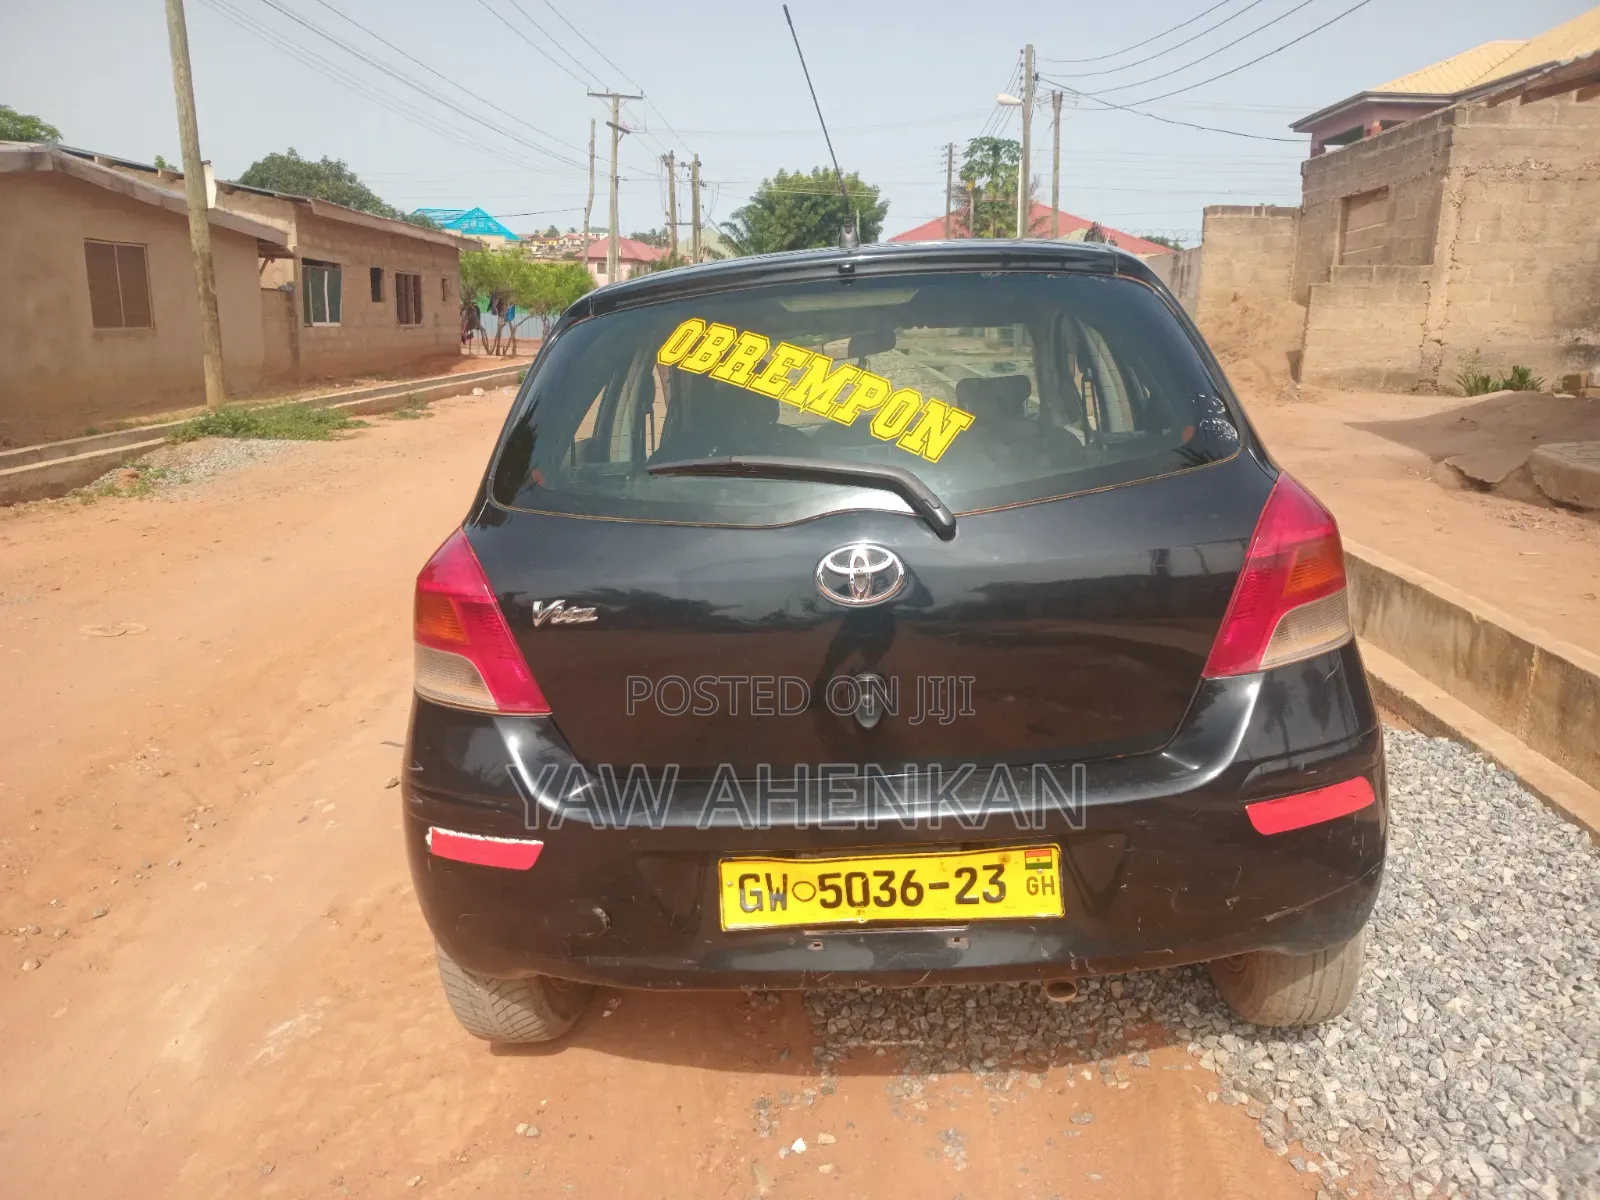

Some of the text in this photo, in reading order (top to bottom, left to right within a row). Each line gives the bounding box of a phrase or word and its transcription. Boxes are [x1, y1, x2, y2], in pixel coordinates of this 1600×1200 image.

[658, 317, 976, 463] OBREMPON
[739, 863, 1007, 913] GW 5036-23
[1026, 876, 1056, 896] GH
